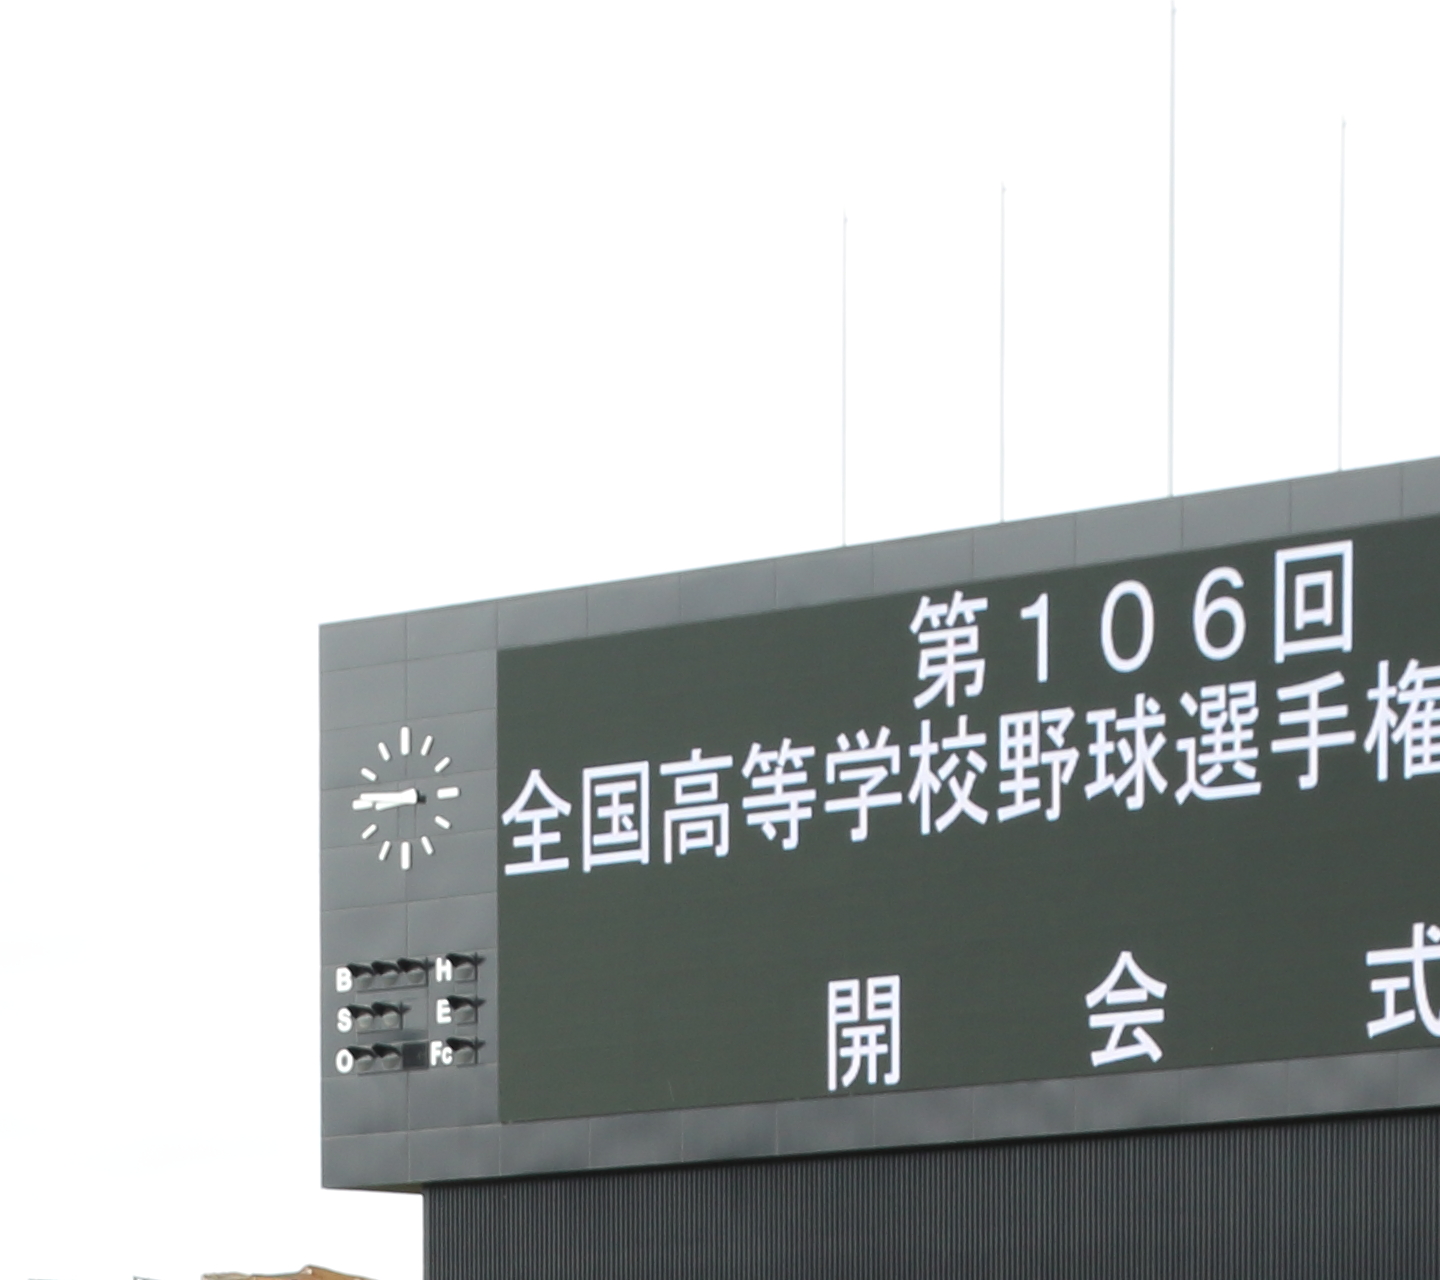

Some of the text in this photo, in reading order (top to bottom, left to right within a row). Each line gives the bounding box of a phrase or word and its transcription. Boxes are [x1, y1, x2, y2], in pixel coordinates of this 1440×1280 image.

[909, 540, 1353, 708] 第106回
[336, 967, 353, 992] B
[436, 957, 453, 982] H
[337, 1007, 353, 1033] S
[436, 998, 452, 1024] E
[335, 1049, 354, 1073] O
